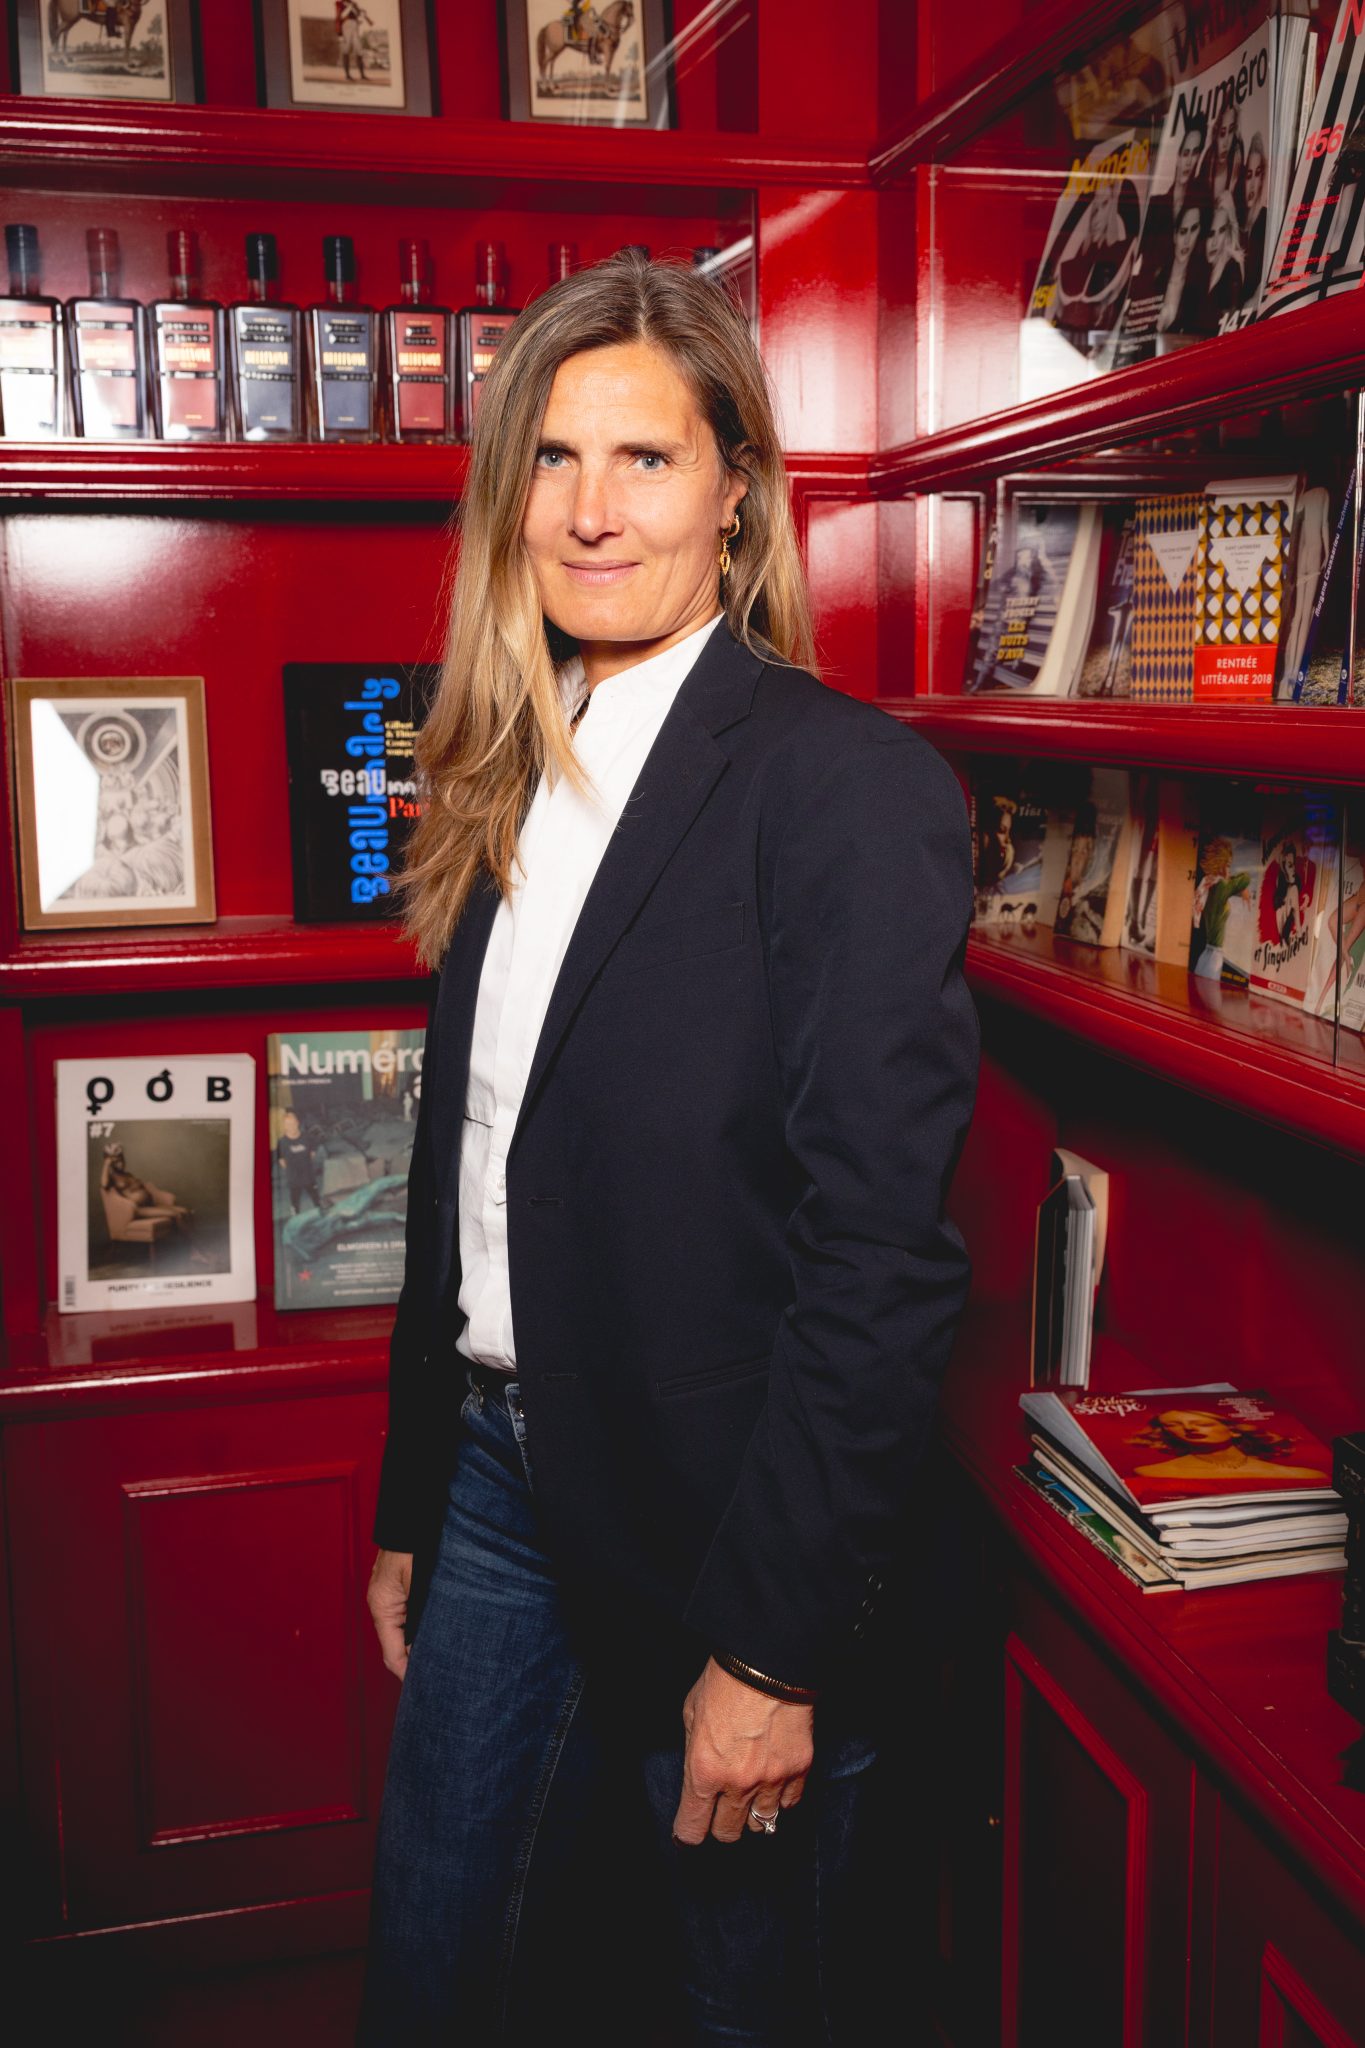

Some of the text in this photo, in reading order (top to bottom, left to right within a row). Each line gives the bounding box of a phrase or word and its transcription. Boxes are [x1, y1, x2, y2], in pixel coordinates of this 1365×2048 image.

[1169, 47, 1268, 138] Numéro
[1304, 122, 1345, 161] 156
[1065, 138, 1150, 197] Numéro
[1218, 307, 1253, 337] 147
[1216, 656, 1258, 669] RENTRÉE
[1201, 672, 1272, 685] LITTÉRAIRE 2018
[89, 1122, 115, 1138] #7
